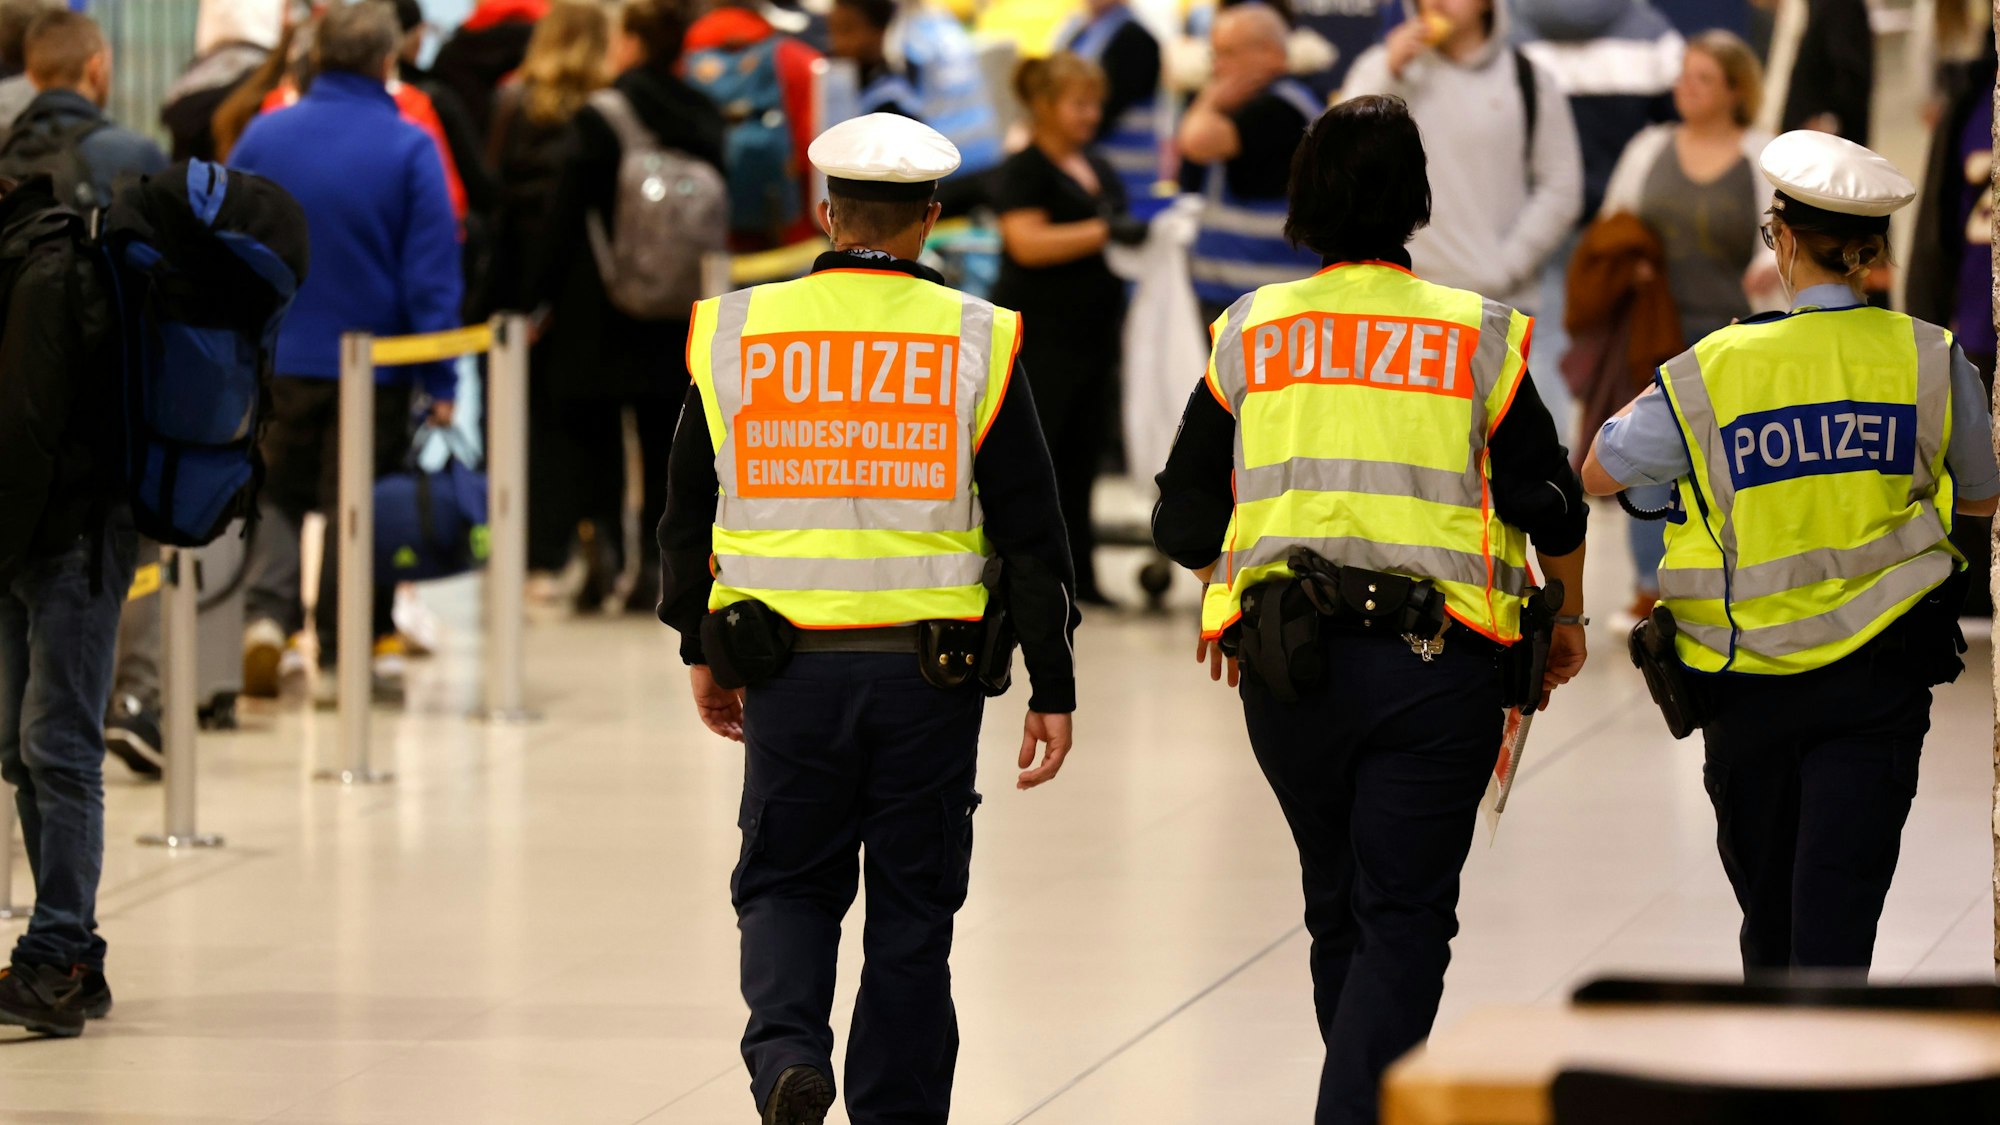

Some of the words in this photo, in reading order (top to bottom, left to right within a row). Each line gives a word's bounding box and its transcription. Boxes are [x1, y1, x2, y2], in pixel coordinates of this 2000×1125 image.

[742, 340, 953, 406] POLIZEI
[1254, 317, 1460, 390] POLIZEI
[745, 420, 947, 450] BUNDESPOLIZEI
[1734, 412, 1897, 475] POLIZEI
[746, 459, 945, 489] EINSATZLEITUNG
